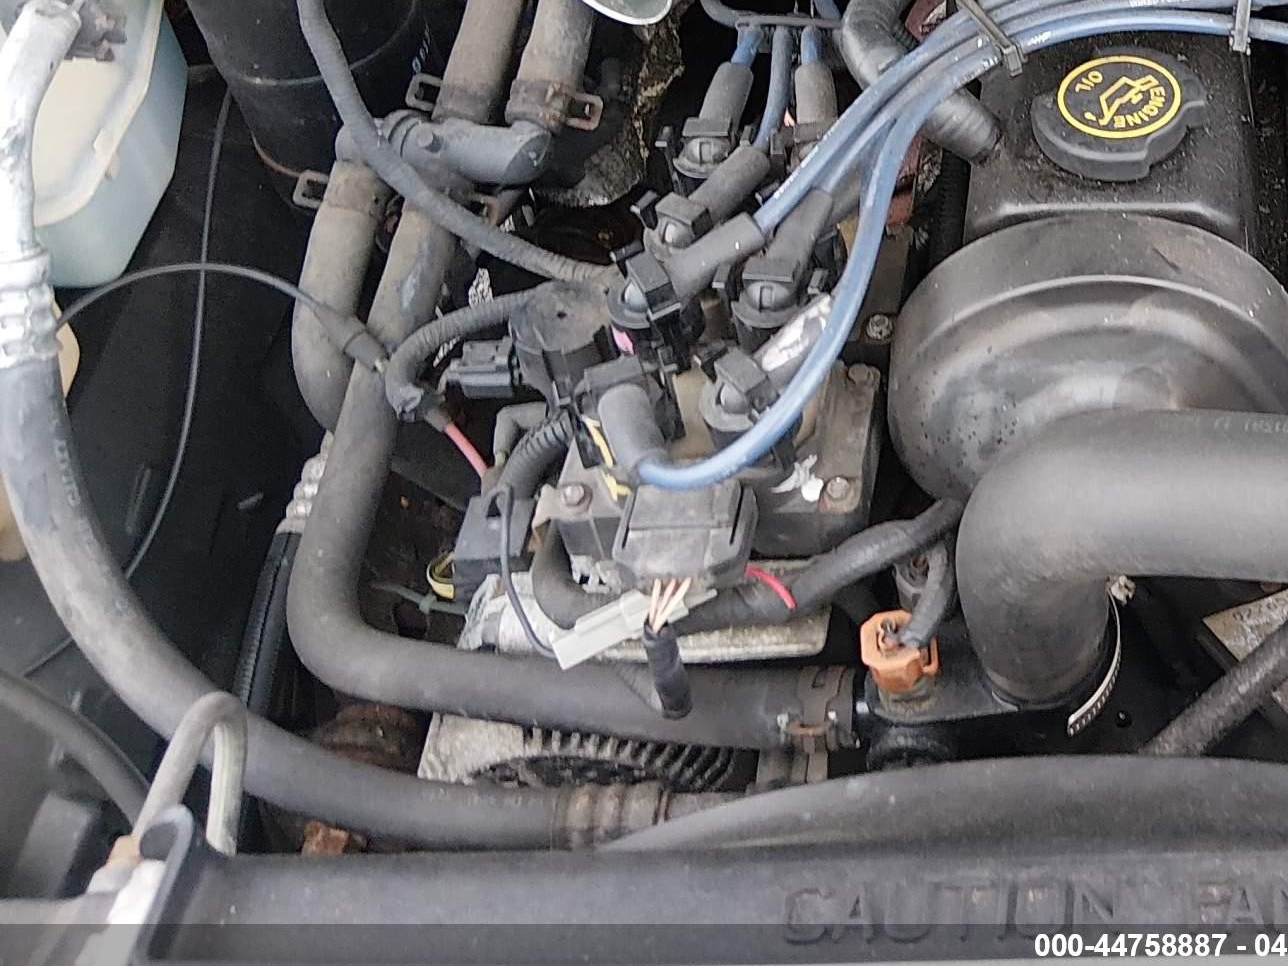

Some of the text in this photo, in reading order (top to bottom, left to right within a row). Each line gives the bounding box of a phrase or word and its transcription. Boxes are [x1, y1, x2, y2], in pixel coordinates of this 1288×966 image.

[1074, 70, 1104, 94] OIL
[1113, 84, 1168, 129] ENGINE
[783, 875, 1118, 945] CAUTION
